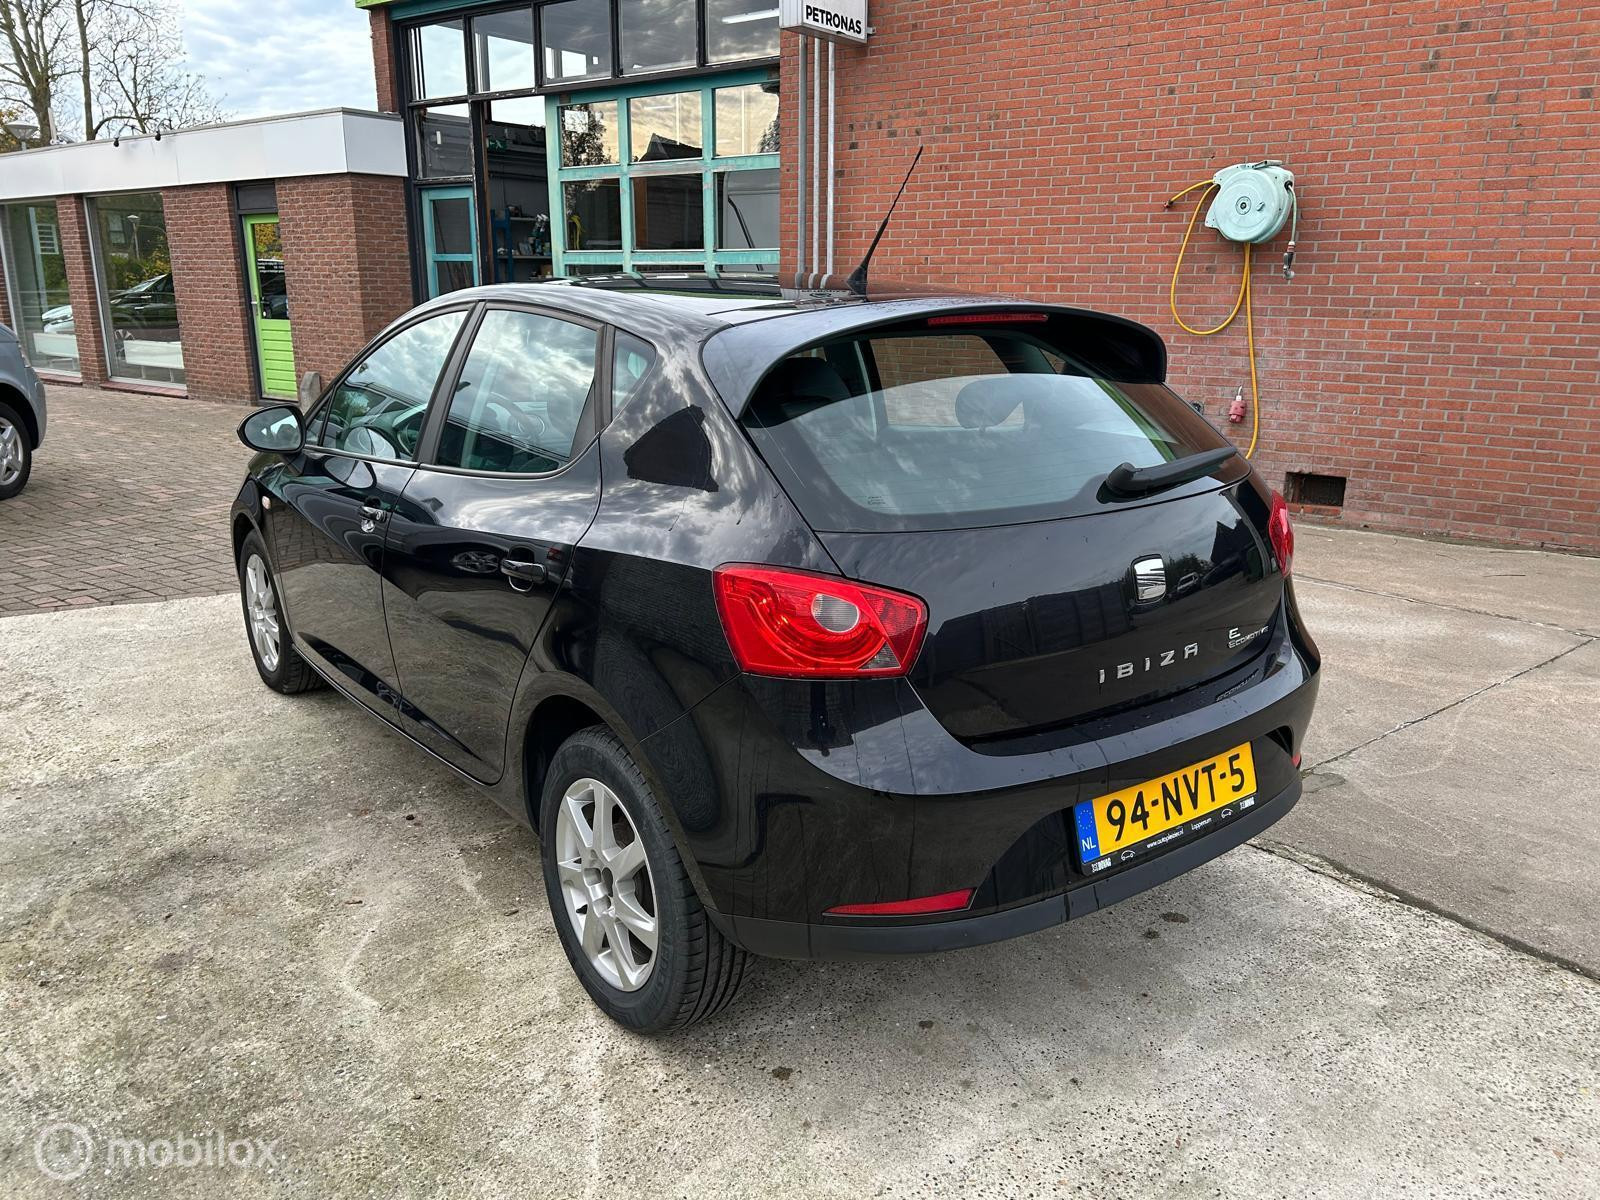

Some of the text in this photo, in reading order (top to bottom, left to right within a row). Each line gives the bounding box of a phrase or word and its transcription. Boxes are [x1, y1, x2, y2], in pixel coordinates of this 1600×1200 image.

[805, 5, 862, 35] PETRONAS
[1228, 627, 1241, 640] E
[1099, 642, 1198, 684] IBIZA
[1106, 753, 1245, 842] 94-NVT-5
[1081, 837, 1097, 851] NL
